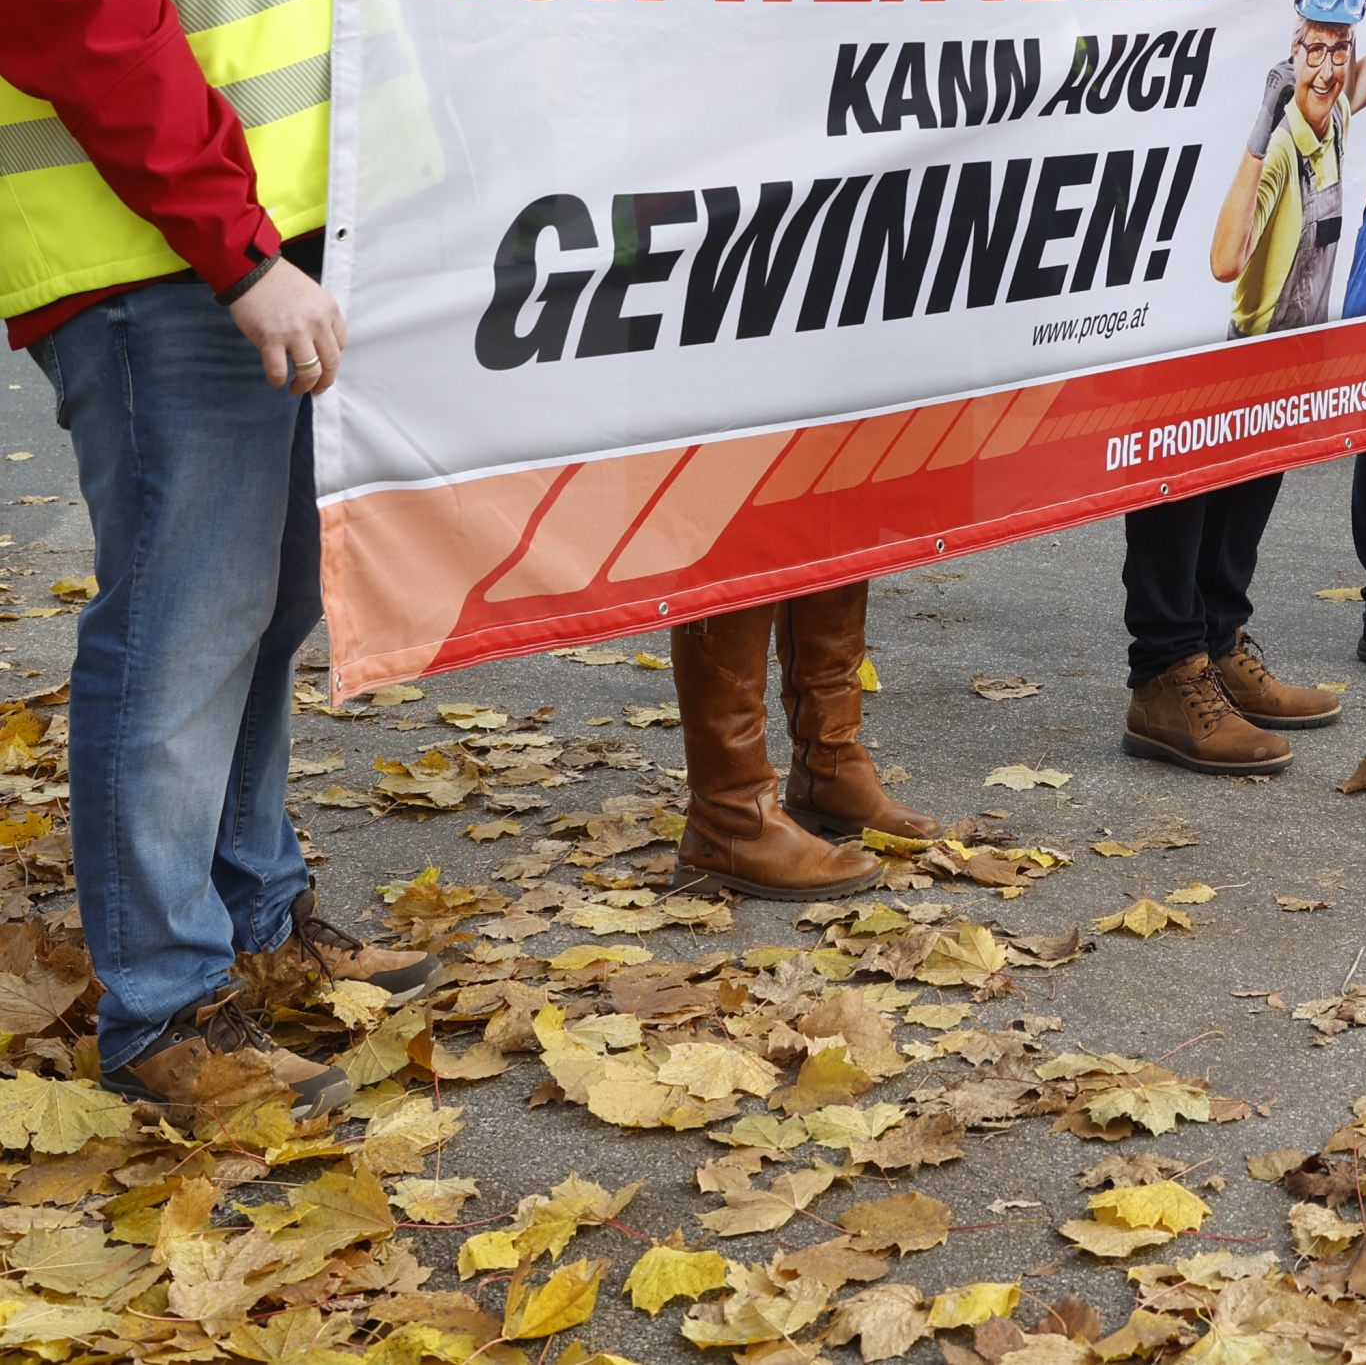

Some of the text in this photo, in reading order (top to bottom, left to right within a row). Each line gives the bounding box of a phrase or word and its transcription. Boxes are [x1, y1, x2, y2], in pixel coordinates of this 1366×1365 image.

[826, 27, 1216, 137] KANN AUCH
[474, 143, 1202, 371] GEWINNEN!
[1031, 302, 1150, 347] www.proge.at
[1106, 433, 1143, 472] DIE
